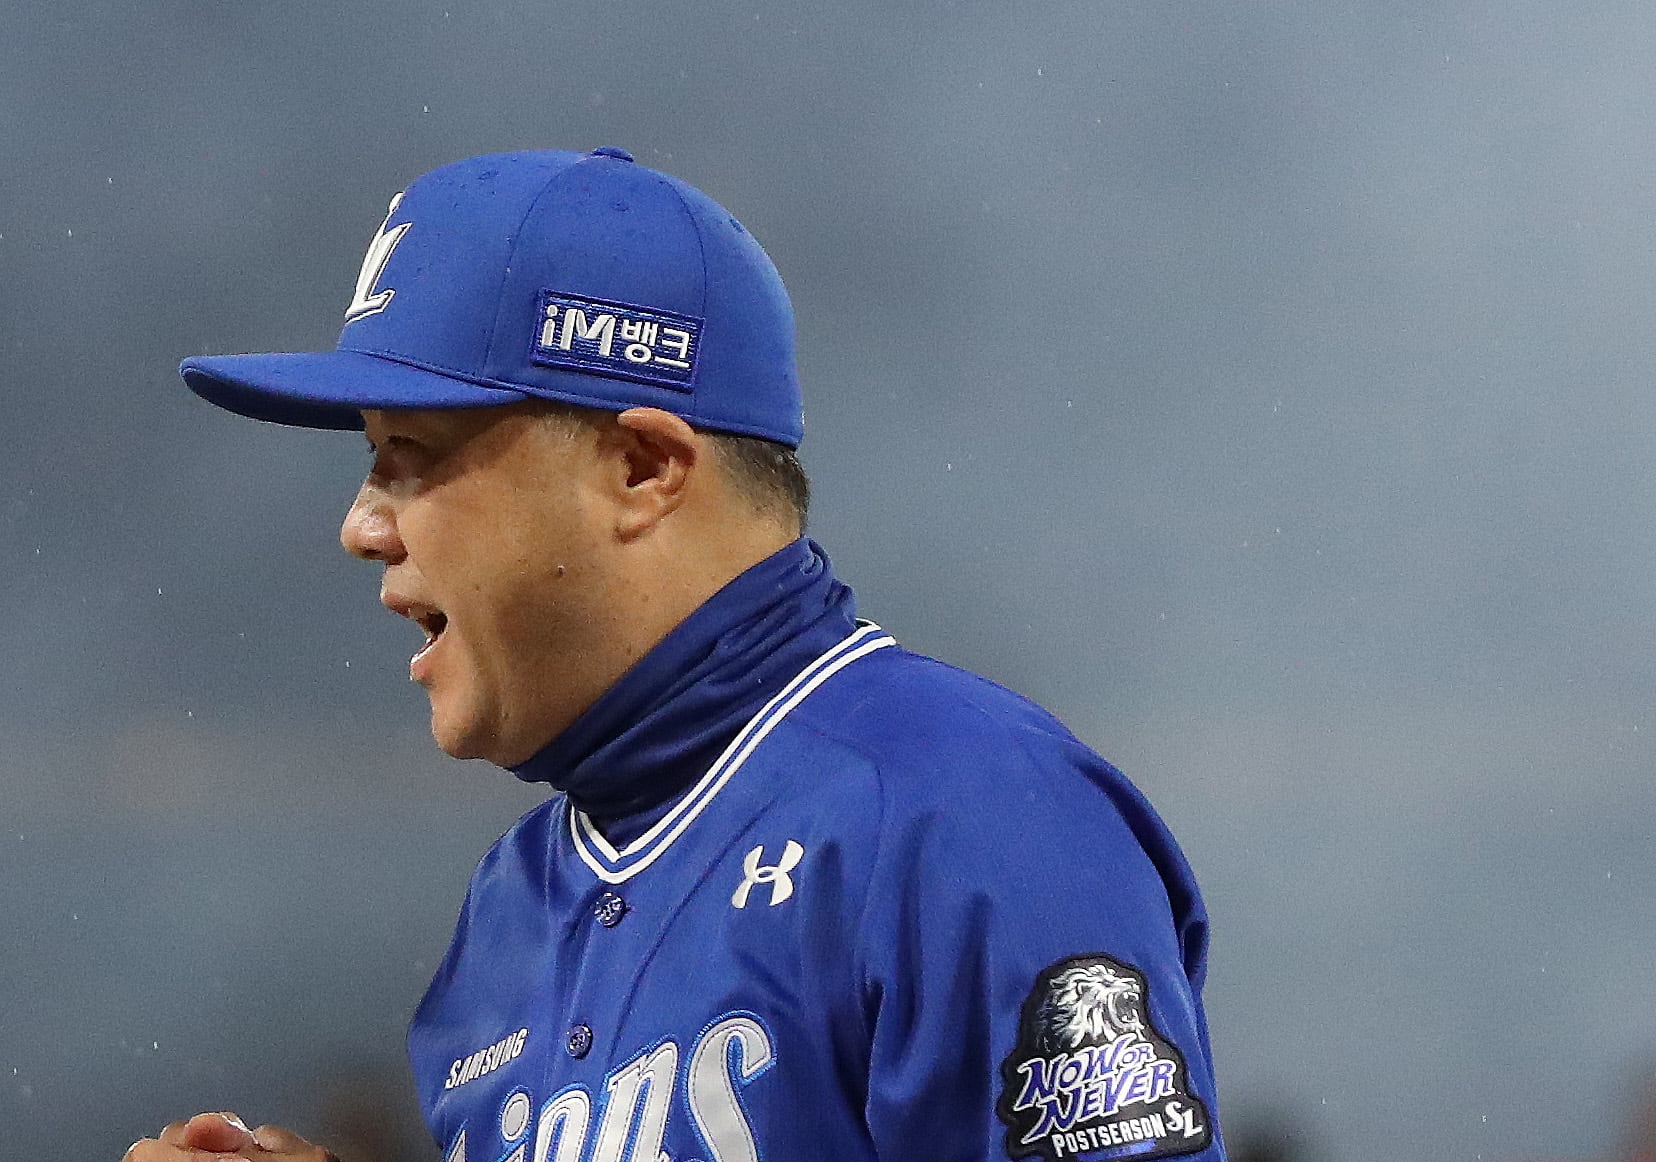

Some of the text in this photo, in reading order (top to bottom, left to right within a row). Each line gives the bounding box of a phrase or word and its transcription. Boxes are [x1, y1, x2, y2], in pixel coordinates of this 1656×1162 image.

[444, 1027, 529, 1090] SAMSUNG
[1013, 1033, 1137, 1111] NOW
[1021, 1059, 1177, 1144] NEVER
[1051, 1112, 1167, 1158] POSTSEASON
